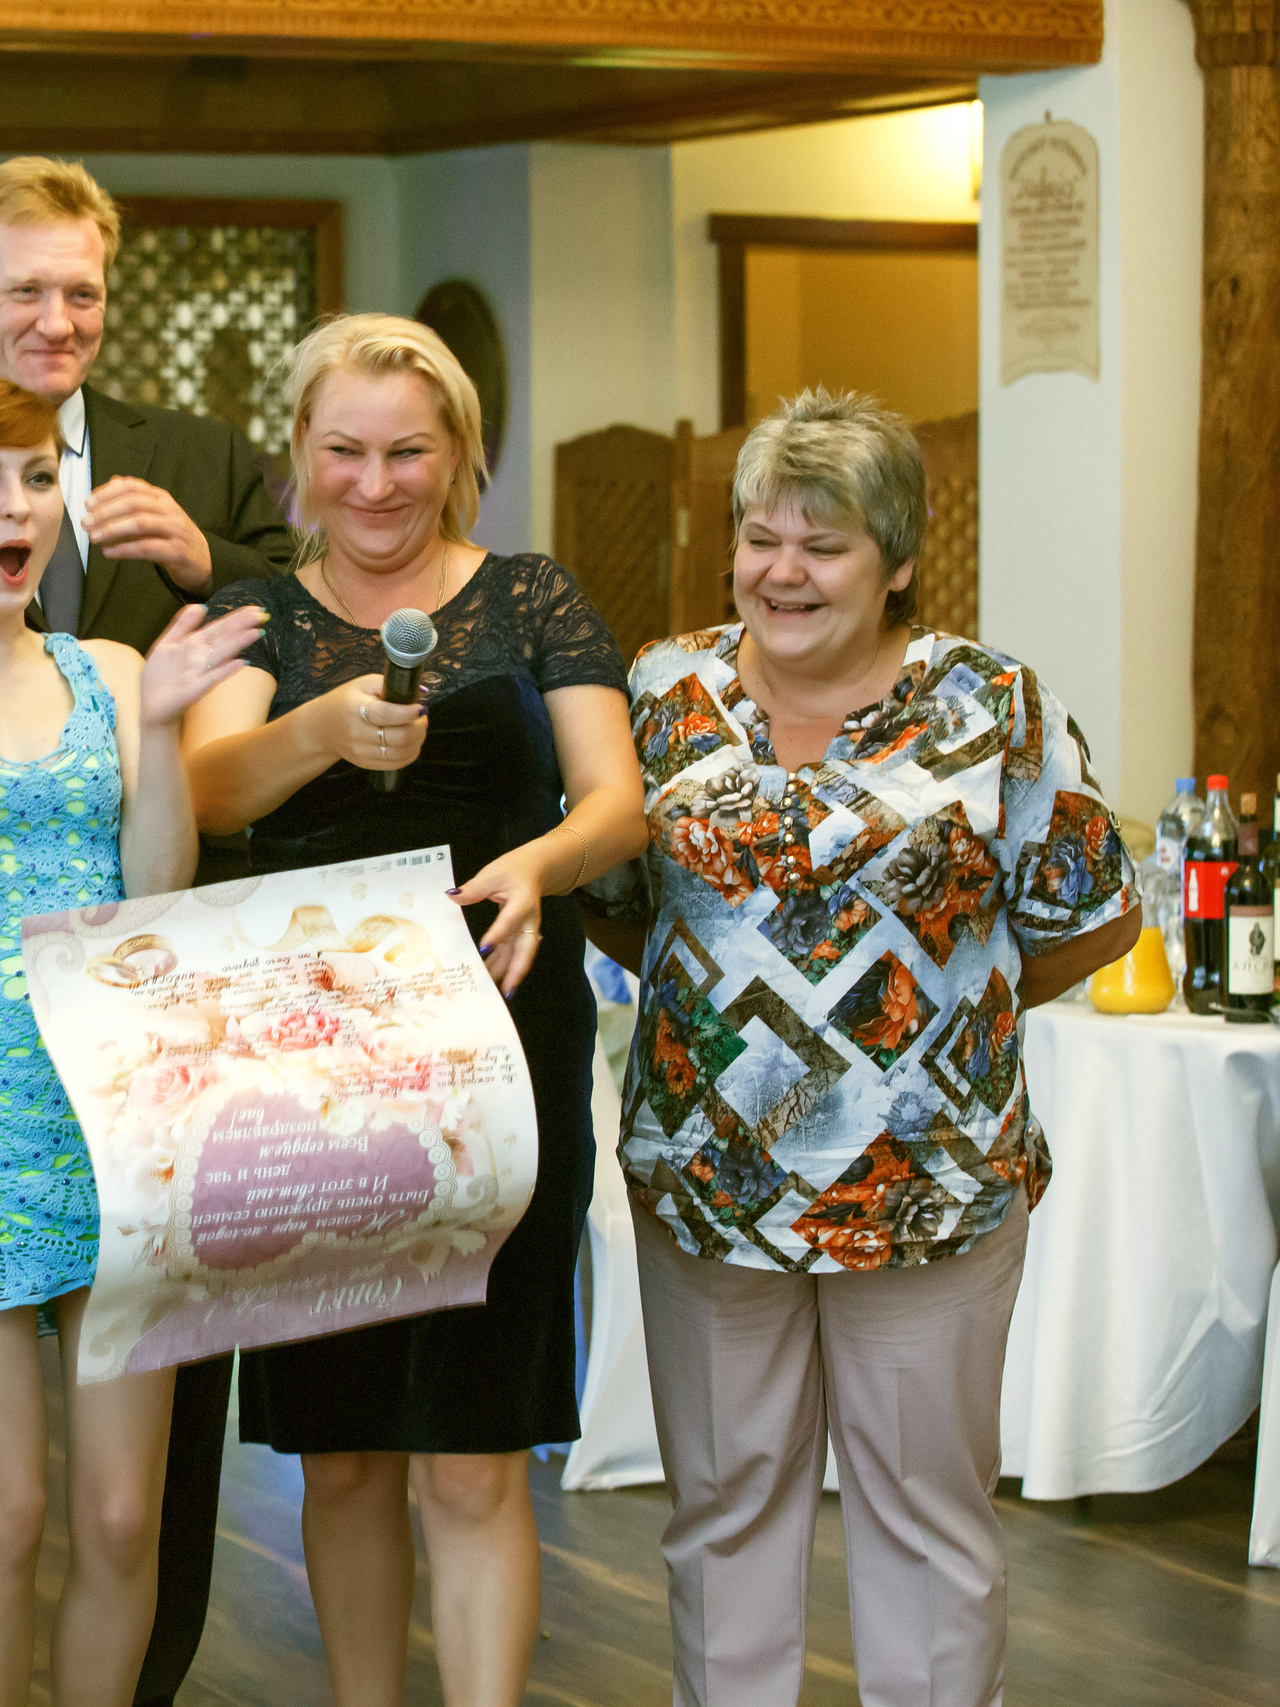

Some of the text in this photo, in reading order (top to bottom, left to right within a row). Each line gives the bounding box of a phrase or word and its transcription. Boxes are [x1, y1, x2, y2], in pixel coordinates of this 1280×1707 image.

[228, 1107, 265, 1130] вас!
[212, 1119, 316, 1143] поздравляем
[258, 1135, 369, 1158] Всем сердцем
[204, 1162, 291, 1184] день и час
[245, 1174, 389, 1204] И в этот светлый
[192, 1188, 429, 1227] Быть очень дружною семьей
[196, 1208, 413, 1244] Желаем паре молодой
